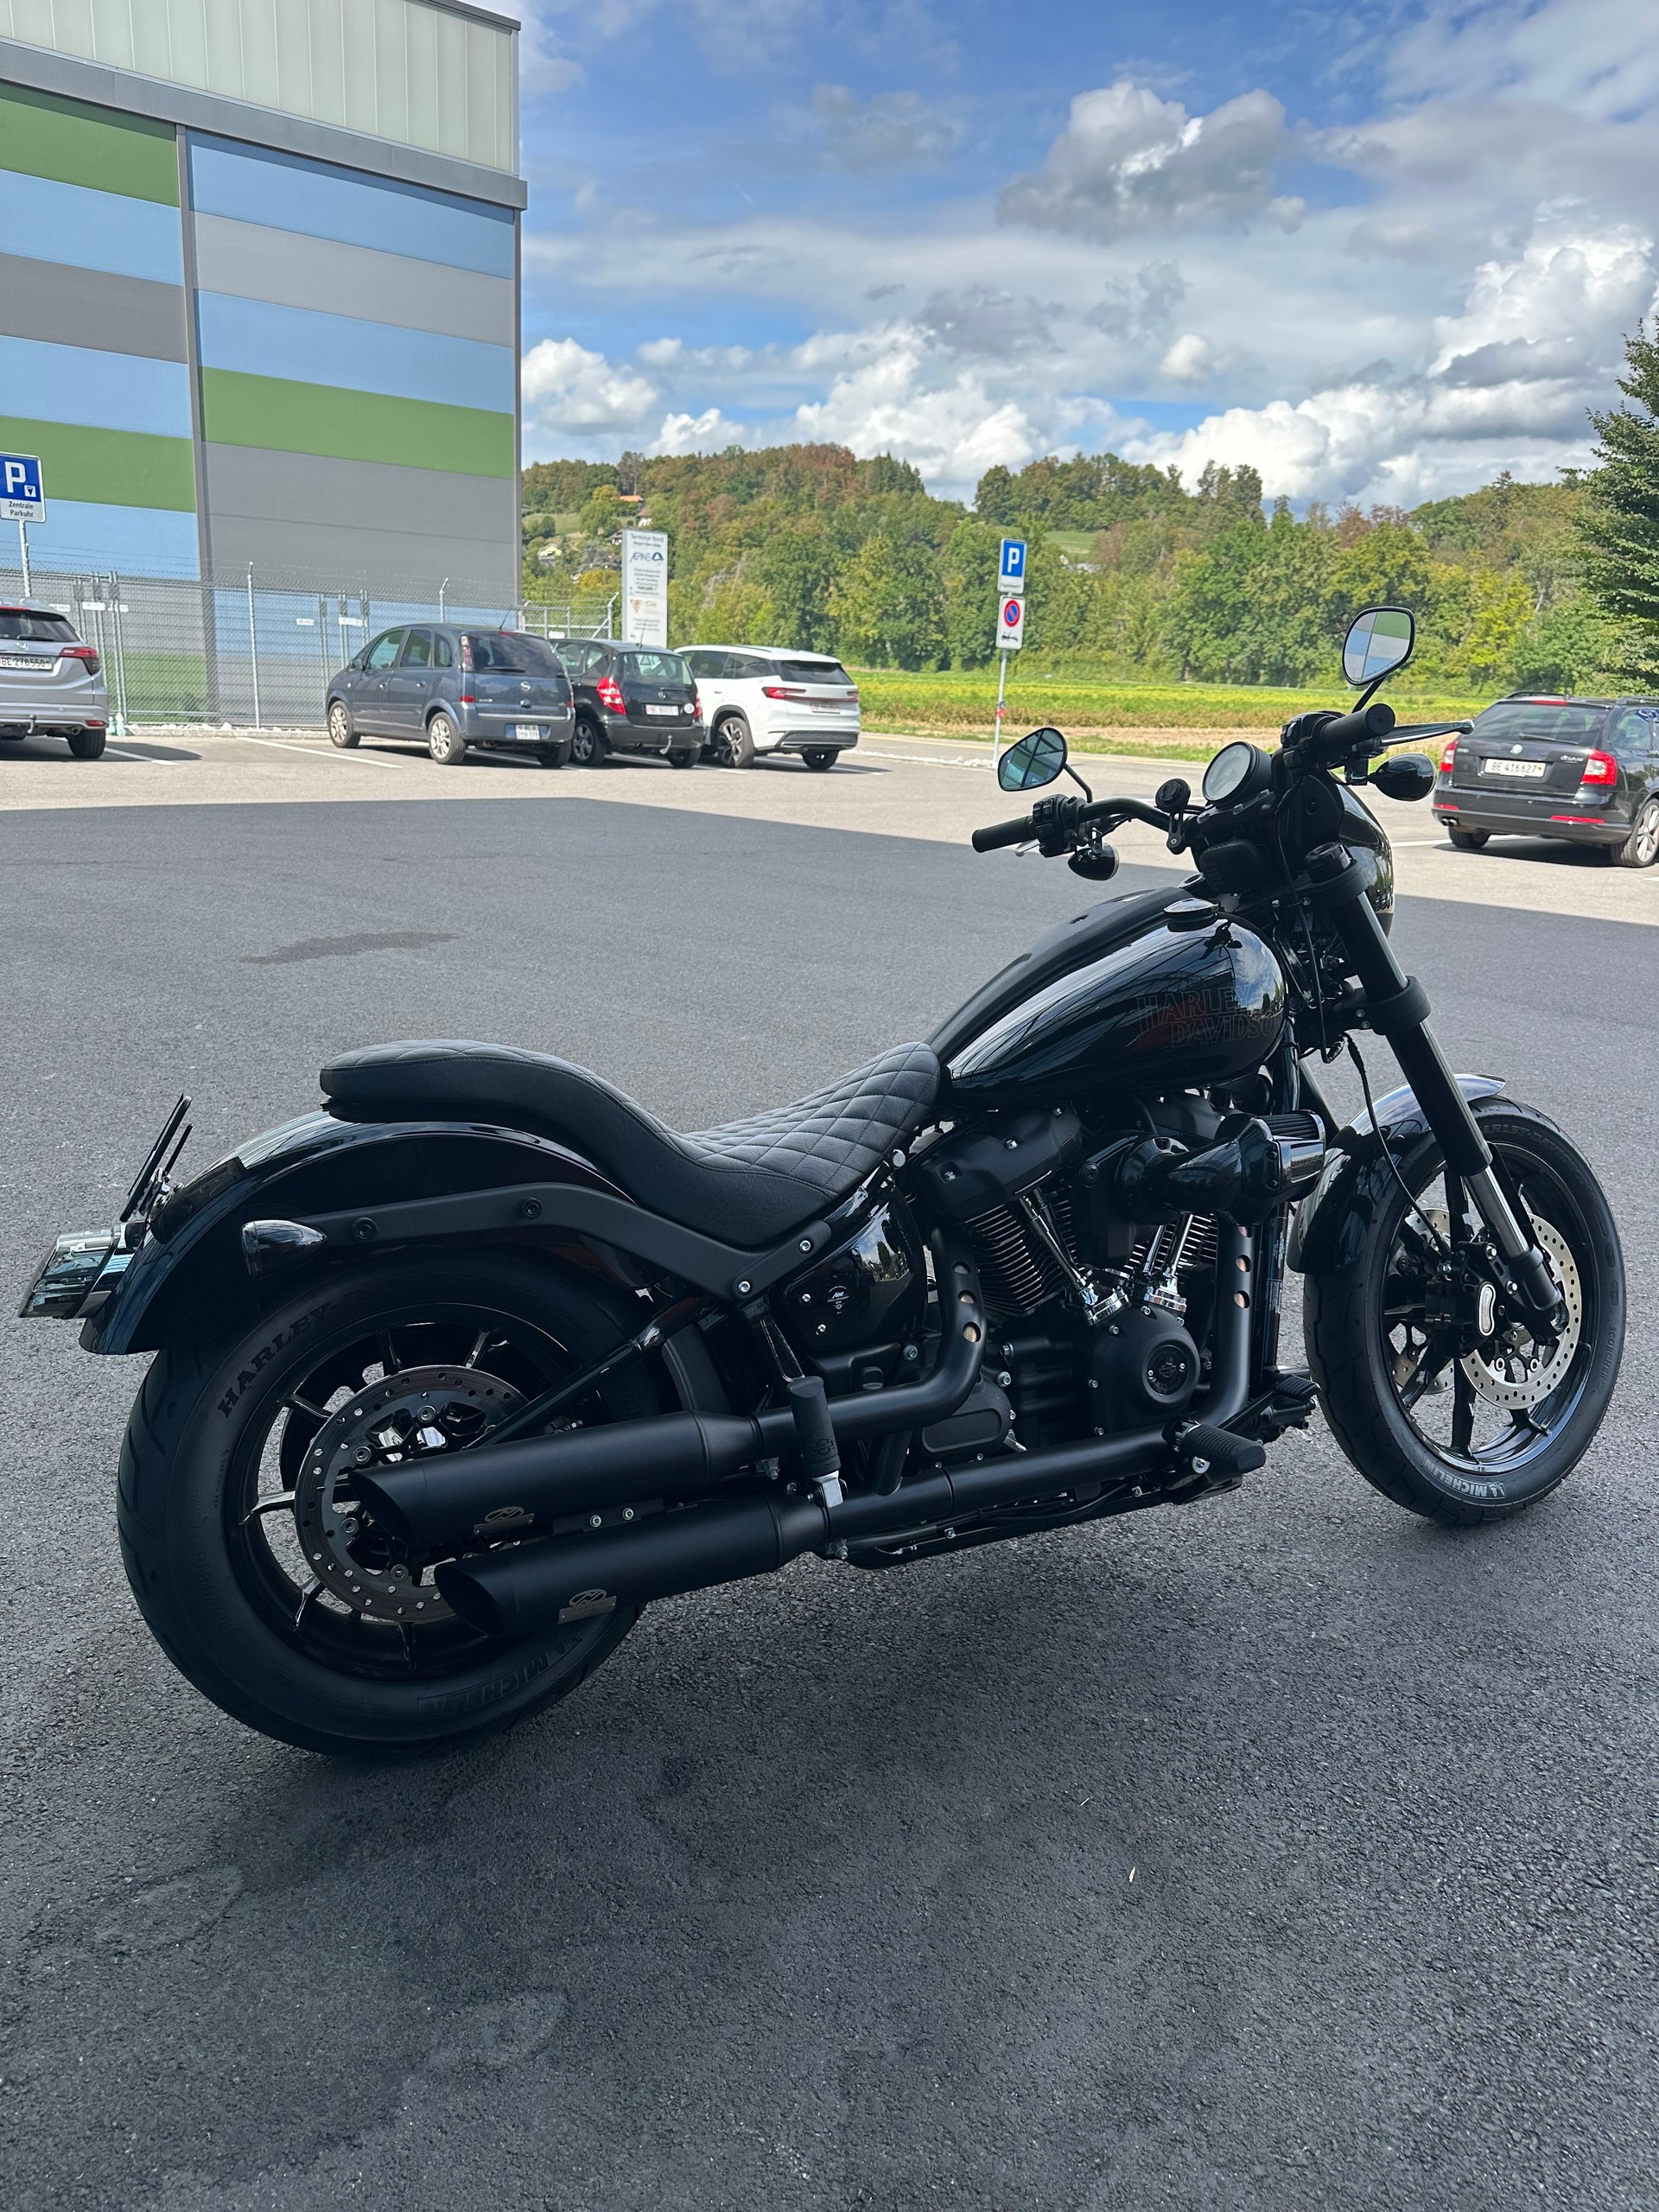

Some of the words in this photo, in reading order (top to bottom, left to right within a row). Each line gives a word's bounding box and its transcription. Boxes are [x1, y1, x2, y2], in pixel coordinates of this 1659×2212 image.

[4, 461, 27, 493] P
[9, 500, 35, 510] Zentrale
[1007, 547, 1020, 573] P
[1491, 761, 1503, 772] BE
[1504, 763, 1537, 773] 416627
[1135, 984, 1251, 1035] HARLEY
[1171, 1009, 1281, 1049] DAVIDSO
[1424, 1458, 1488, 1497] MICHELIN
